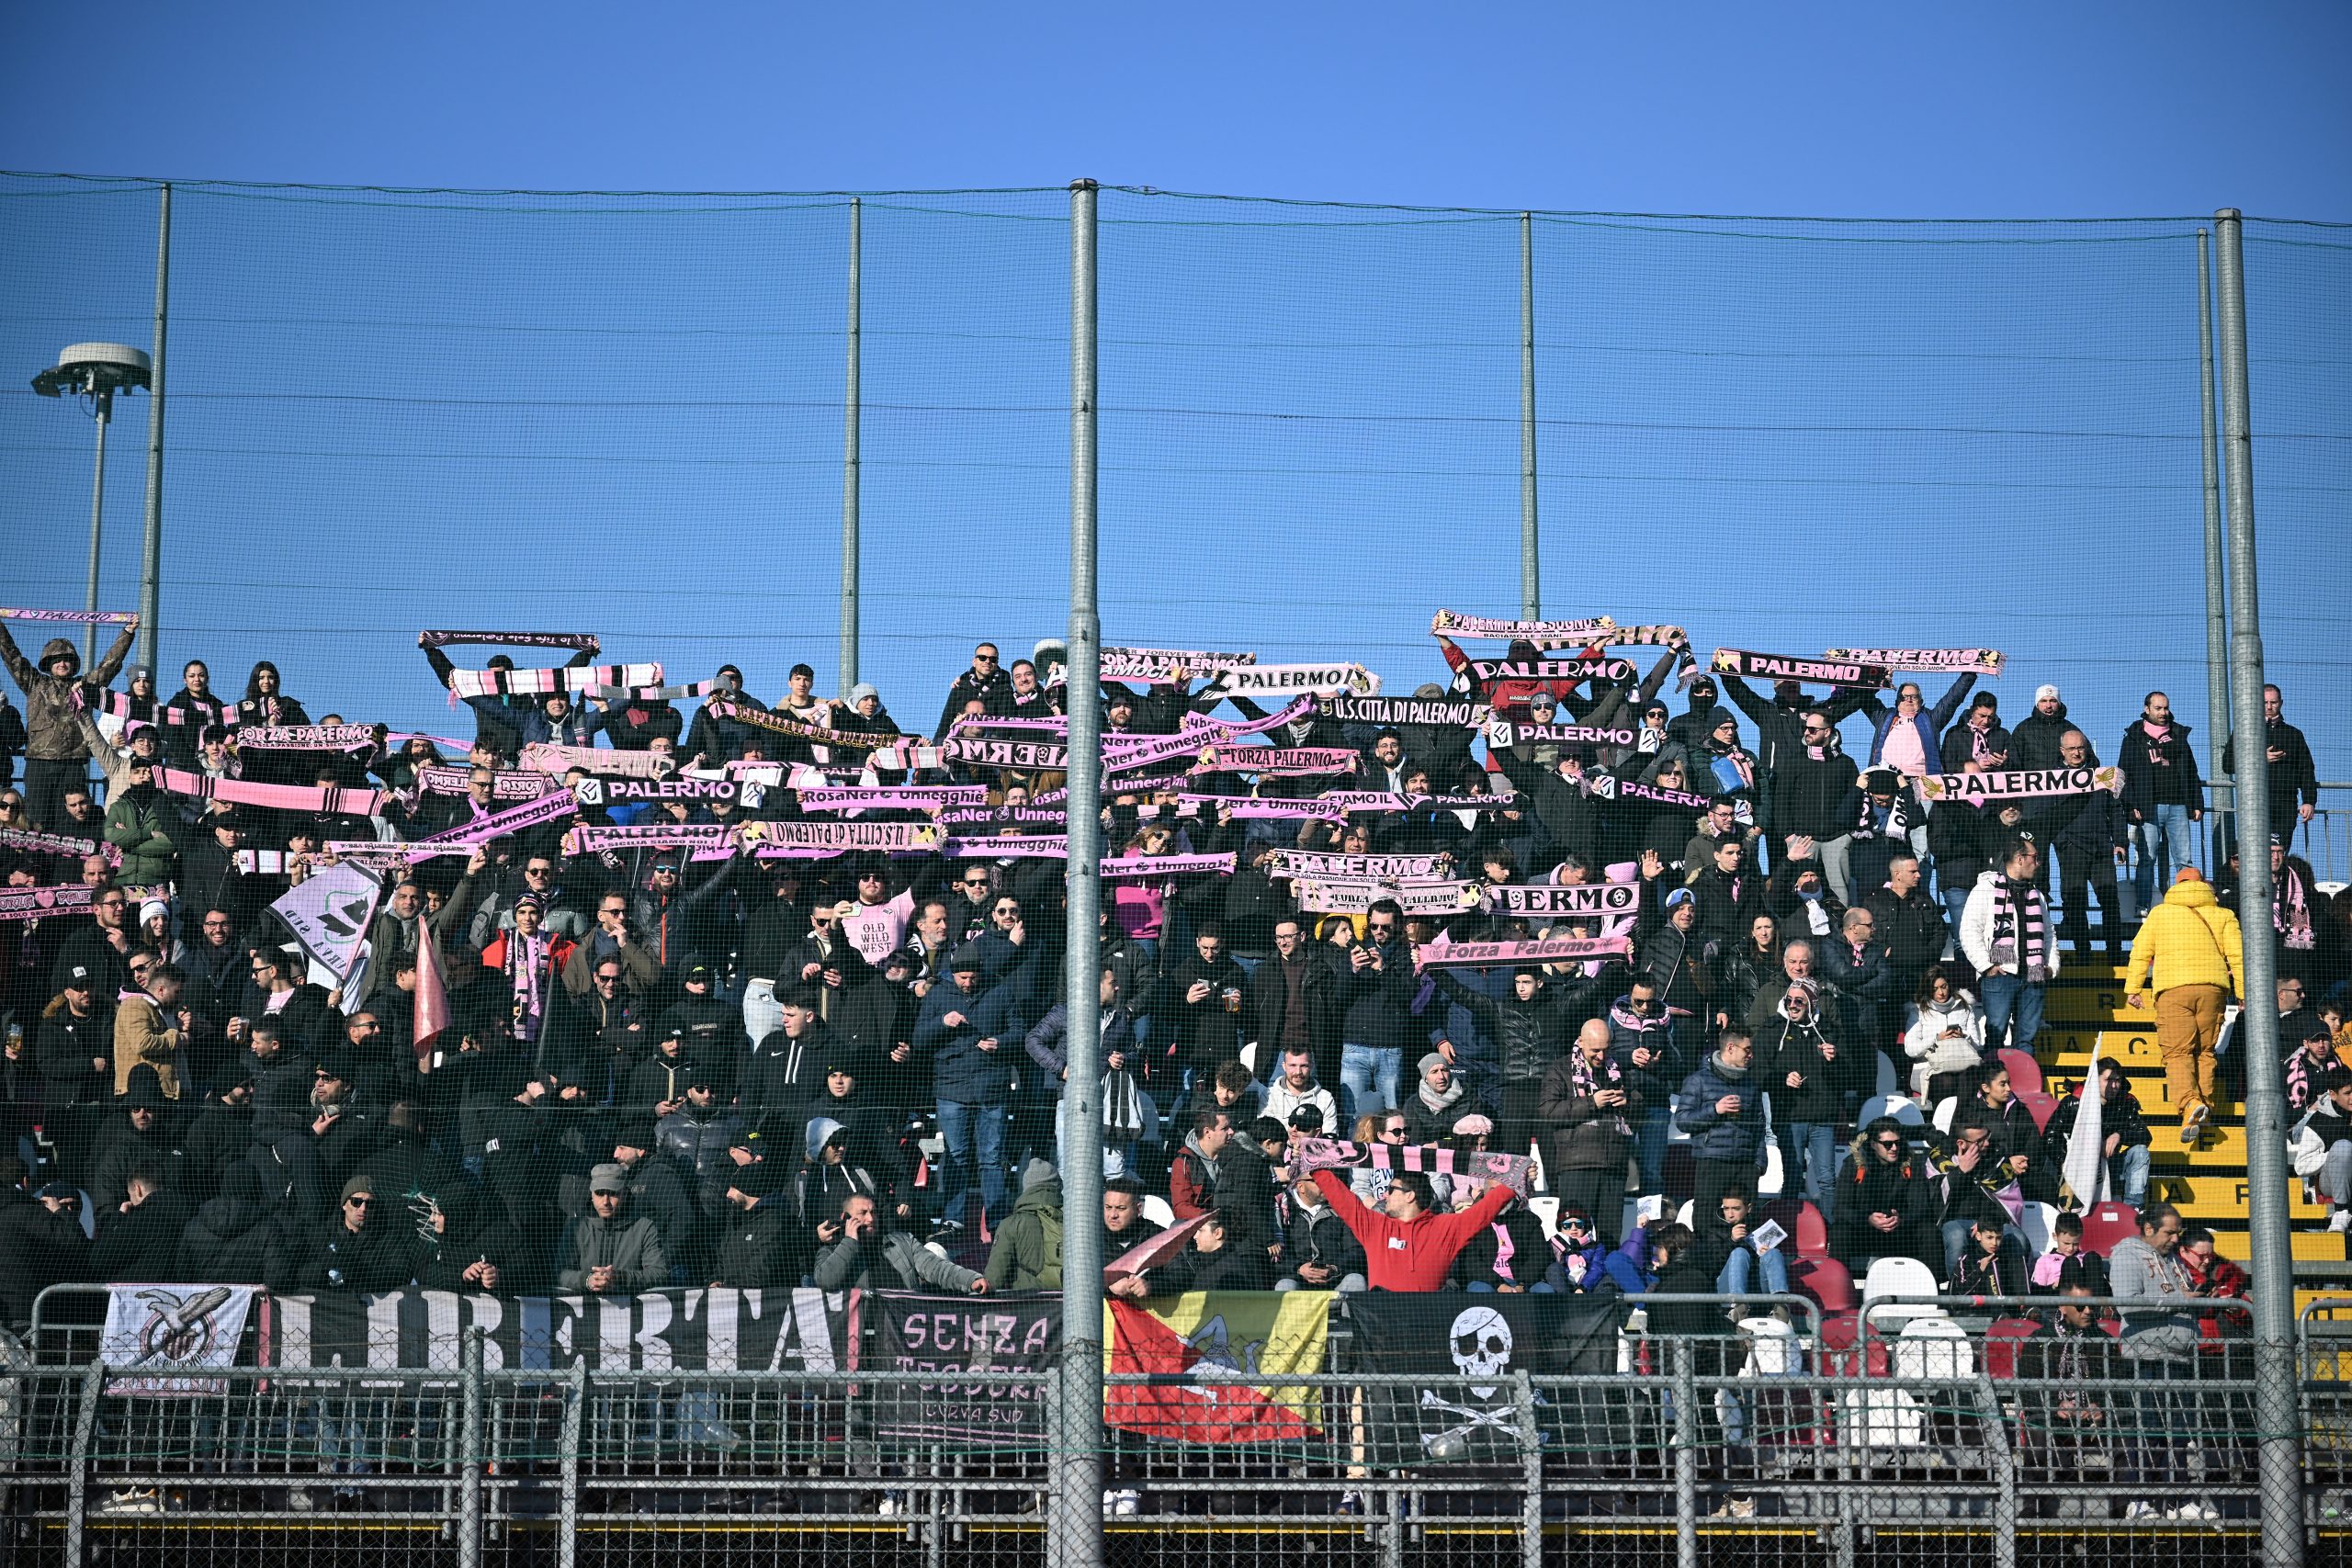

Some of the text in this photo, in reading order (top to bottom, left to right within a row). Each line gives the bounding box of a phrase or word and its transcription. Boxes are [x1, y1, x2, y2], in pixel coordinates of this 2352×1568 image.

[42, 611, 110, 622] PALERMO
[1159, 656, 1238, 671] PALERMO
[1849, 649, 1979, 664] PALERMO
[1472, 660, 1631, 680] PALERMO
[1750, 656, 1860, 682] PALERMO
[1238, 670, 1342, 689] PALERMO
[1394, 701, 1408, 723] DI
[1409, 702, 1469, 725] PALERMO
[237, 724, 374, 742] FORZA PALERMO
[1153, 725, 1223, 755] Unneggh
[1519, 724, 1634, 745] PALERMO
[1230, 748, 1332, 767] FORZA PALERMO
[820, 767, 865, 775] PALE
[609, 781, 735, 798] PALERMO
[1945, 768, 2094, 795] PALERMO
[1379, 794, 1392, 804] IL
[1436, 794, 1514, 804] PALERMO
[1622, 781, 1712, 808] PALERM
[1014, 807, 1069, 824] Unneg
[586, 827, 718, 842] PALERMO
[775, 821, 831, 842] PALERMO
[1288, 853, 1433, 876] PALERMO
[0, 890, 92, 909] ORZA PALE
[1498, 887, 1634, 912] LERMO
[863, 923, 886, 932] OLD
[861, 932, 889, 943] WILD
[860, 942, 892, 953] WEST
[1444, 939, 1596, 959] Forza Palermo
[903, 1314, 1047, 1354] SENZA
[926, 1404, 1023, 1423] CURVA SUD
